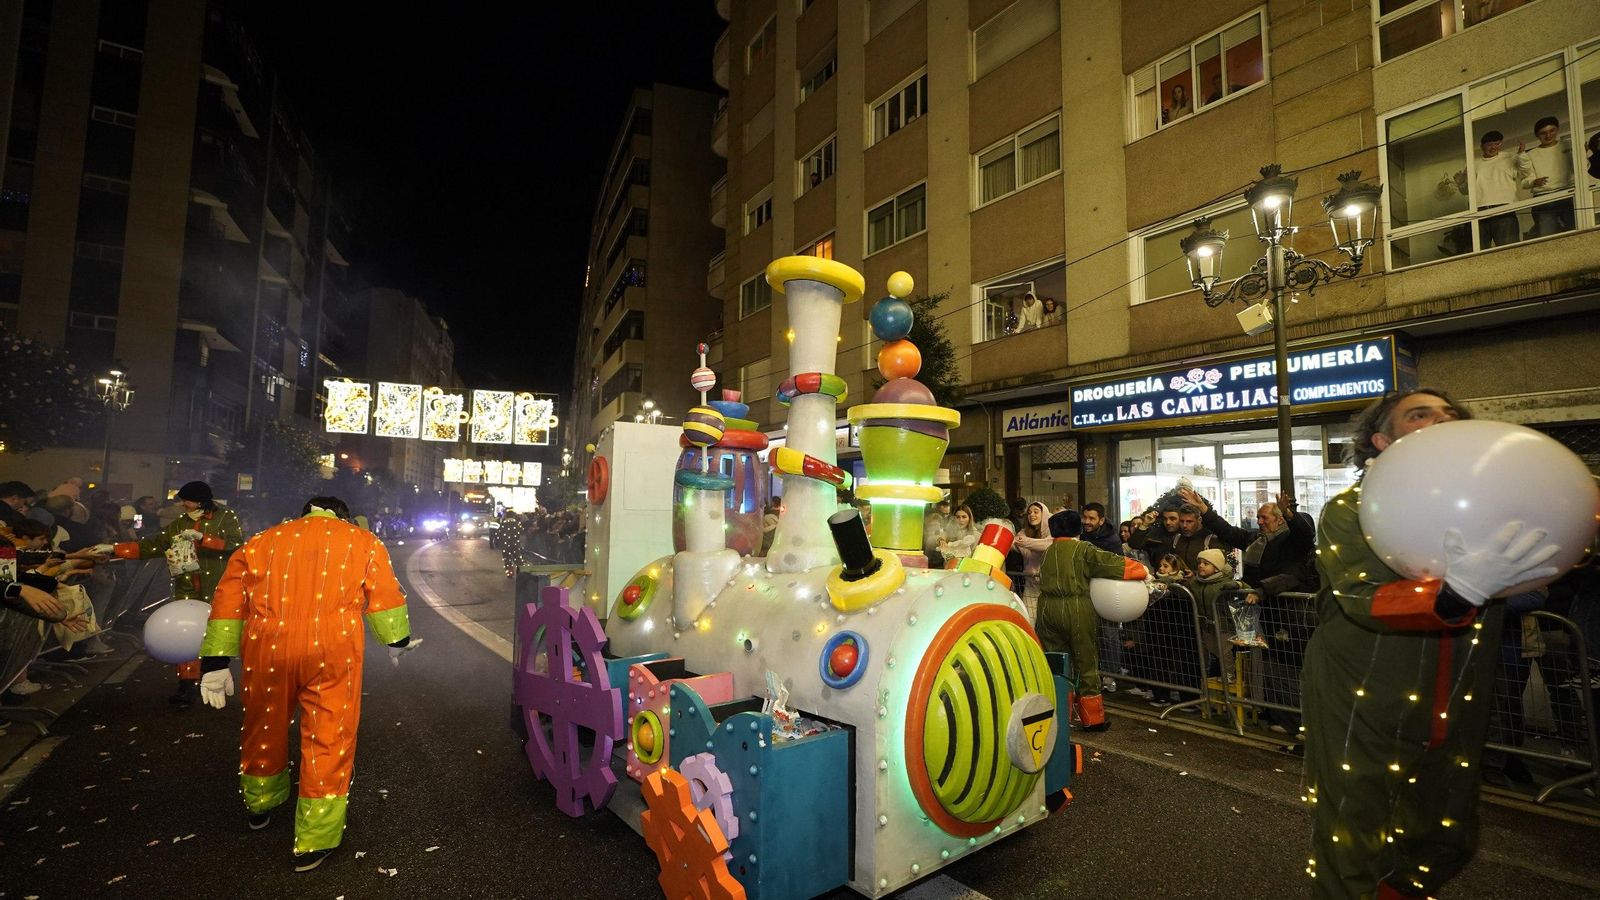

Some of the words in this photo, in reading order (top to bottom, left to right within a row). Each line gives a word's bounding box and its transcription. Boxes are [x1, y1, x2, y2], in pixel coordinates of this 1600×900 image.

[1073, 377, 1165, 403] DROGUERÍA
[1293, 378, 1385, 401] COMPLEMENTOS
[1116, 401, 1154, 421] LAS
